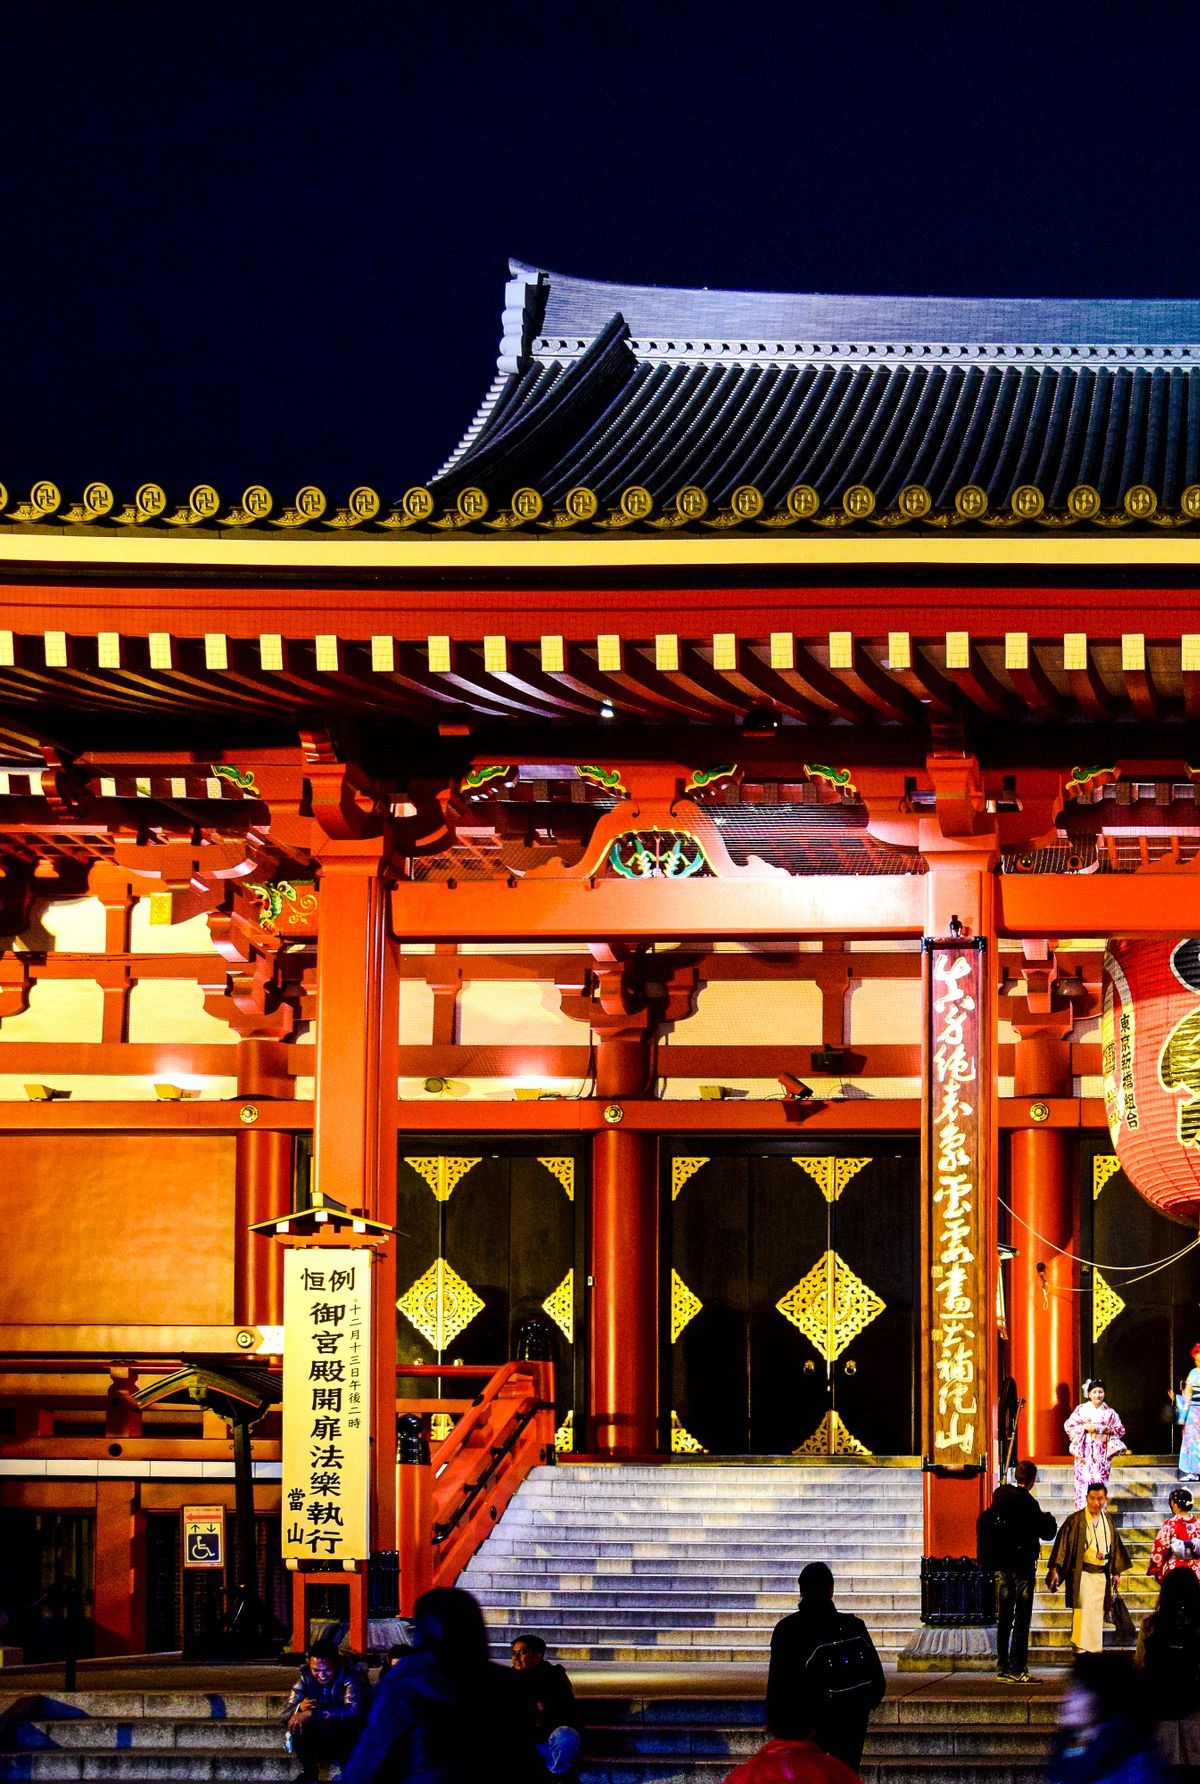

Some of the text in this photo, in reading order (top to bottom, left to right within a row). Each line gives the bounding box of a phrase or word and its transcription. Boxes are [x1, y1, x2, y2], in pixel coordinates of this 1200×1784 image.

[300, 1267, 355, 1292] 恒例
[348, 1304, 361, 1429] 十二月十三日午後二時
